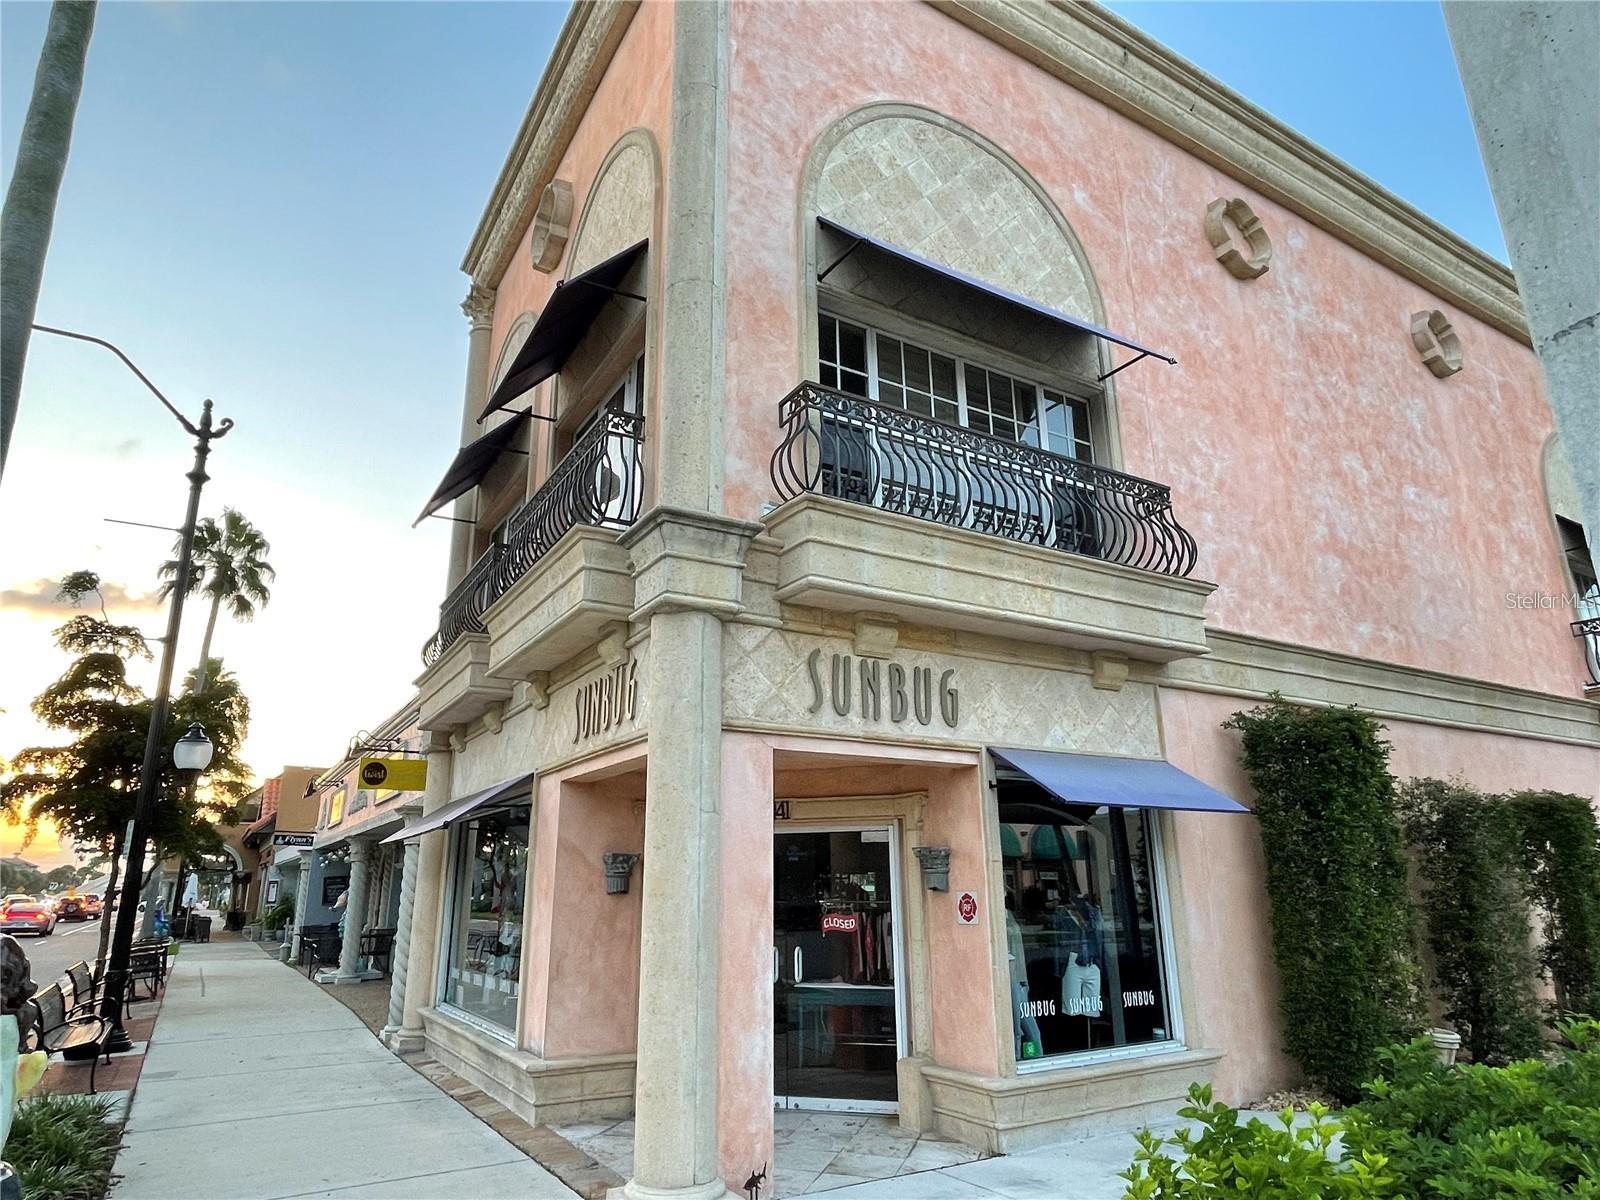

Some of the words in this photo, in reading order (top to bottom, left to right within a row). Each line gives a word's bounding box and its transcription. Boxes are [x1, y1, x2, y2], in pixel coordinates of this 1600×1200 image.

[808, 648, 959, 728] SUNBUG
[573, 658, 638, 744] SUNBUG
[774, 800, 791, 820] 41
[823, 917, 856, 929] CLOSED
[1069, 996, 1103, 1014] SUNBUG
[1122, 990, 1155, 1007] SUNBUG
[1020, 1000, 1056, 1018] SUNBUG
